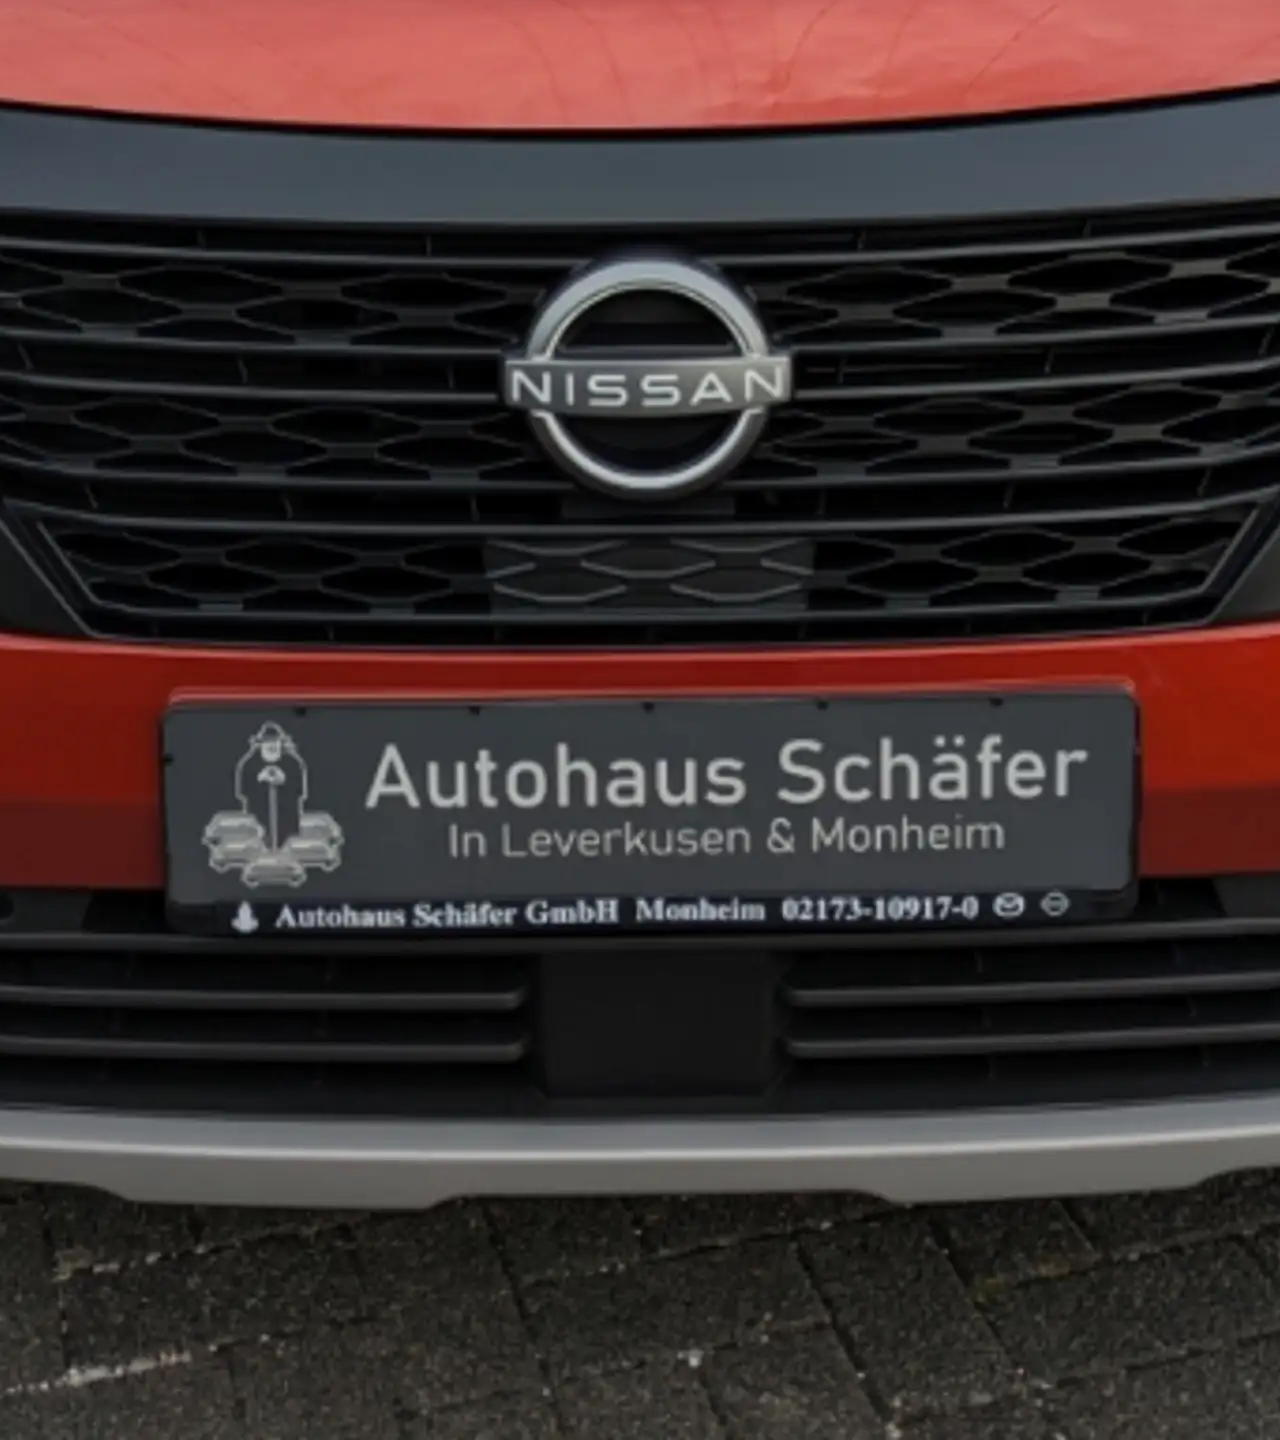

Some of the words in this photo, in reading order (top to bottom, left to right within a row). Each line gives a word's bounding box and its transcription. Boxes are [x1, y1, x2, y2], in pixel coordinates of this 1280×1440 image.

[511, 367, 784, 408] NISSAN
[365, 742, 747, 809] Autohaus
[777, 734, 1089, 805] Schäfer
[449, 823, 487, 858] In
[502, 820, 751, 859] Leverkusen
[766, 817, 795, 854] &
[812, 813, 1005, 854] Monheim
[275, 903, 406, 928] Autohaus
[411, 902, 518, 928] Schäfer
[524, 898, 619, 924] GmbH
[635, 896, 766, 922] Monheim
[781, 894, 979, 921] 02173-10917-0
